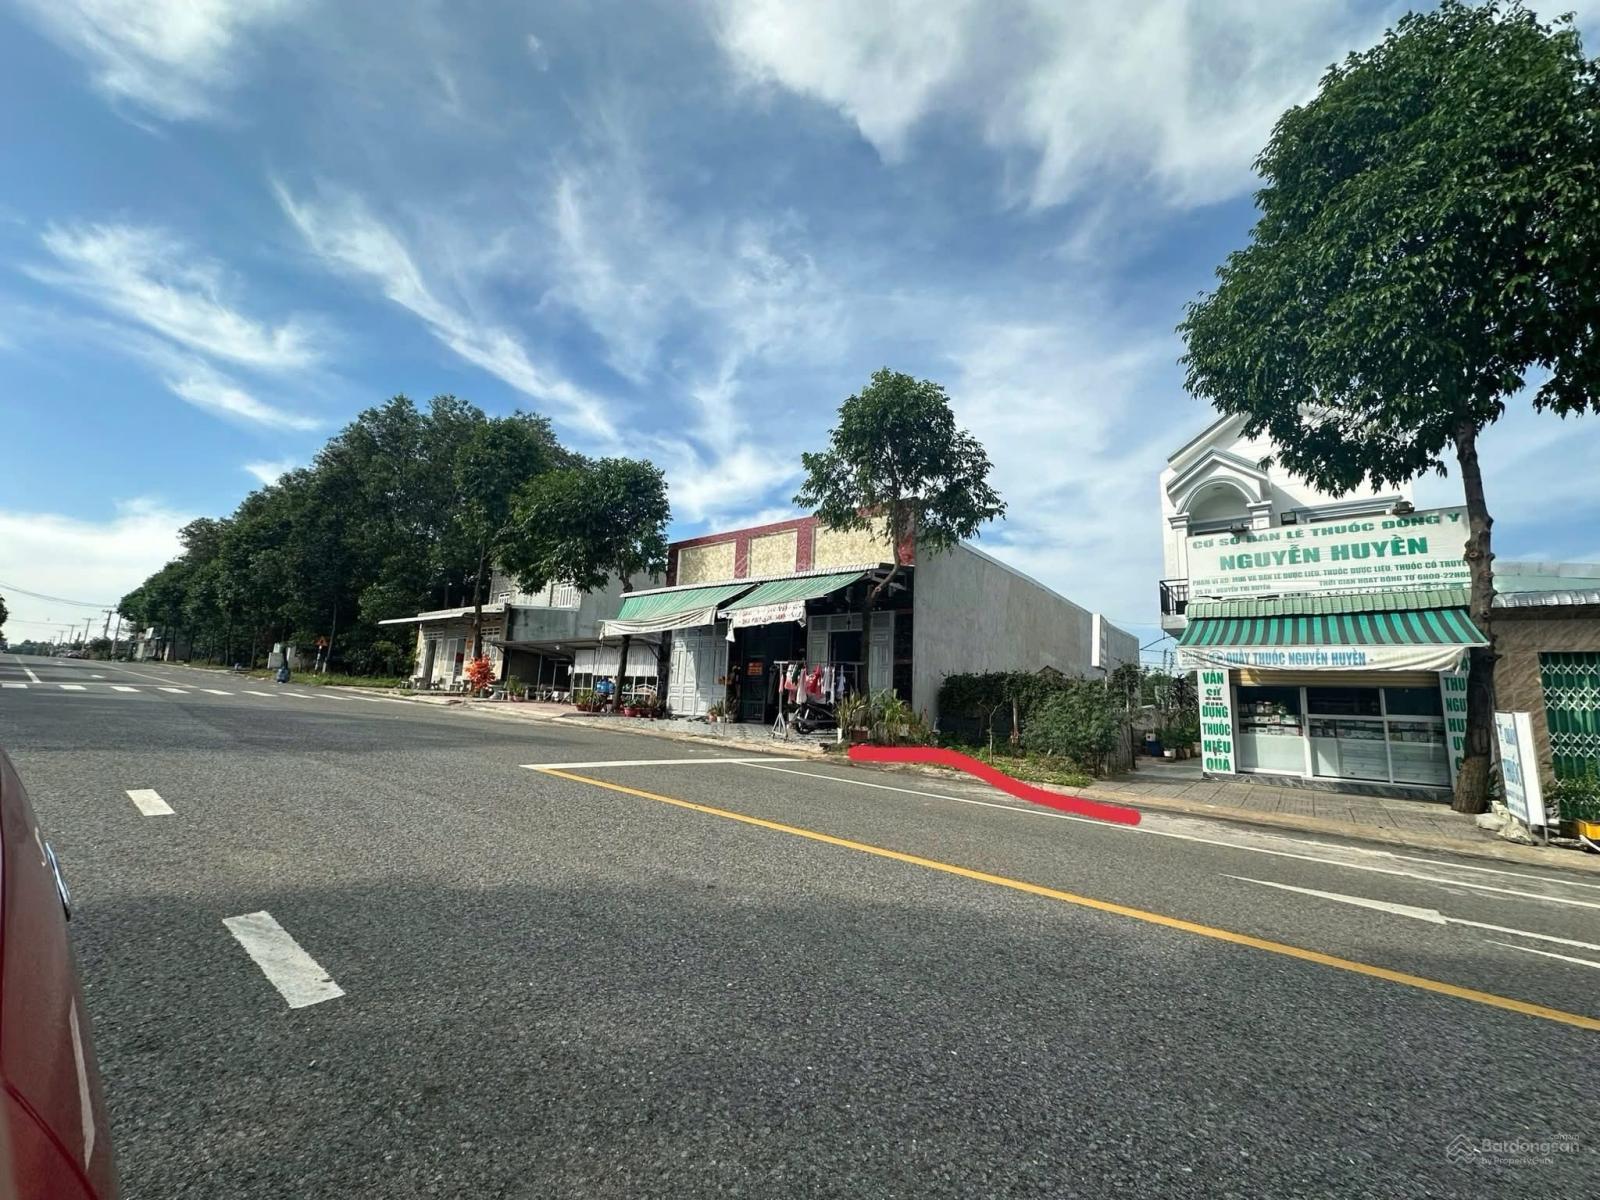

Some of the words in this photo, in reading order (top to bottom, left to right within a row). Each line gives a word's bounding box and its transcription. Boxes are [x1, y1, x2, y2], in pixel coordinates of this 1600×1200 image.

[1310, 521, 1374, 536] THUỐC
[1220, 544, 1320, 570] NGUYỄN
[1330, 534, 1428, 561] HUYỀN
[1252, 647, 1285, 665] THUỐC
[1288, 647, 1327, 665] NGUYỄN
[1331, 647, 1366, 666] HUYỀN
[1202, 705, 1228, 719] DỤNG
[1202, 721, 1231, 736] THUỐC
[1203, 738, 1231, 755] HIỆU
[1206, 756, 1231, 772] QUẢ
